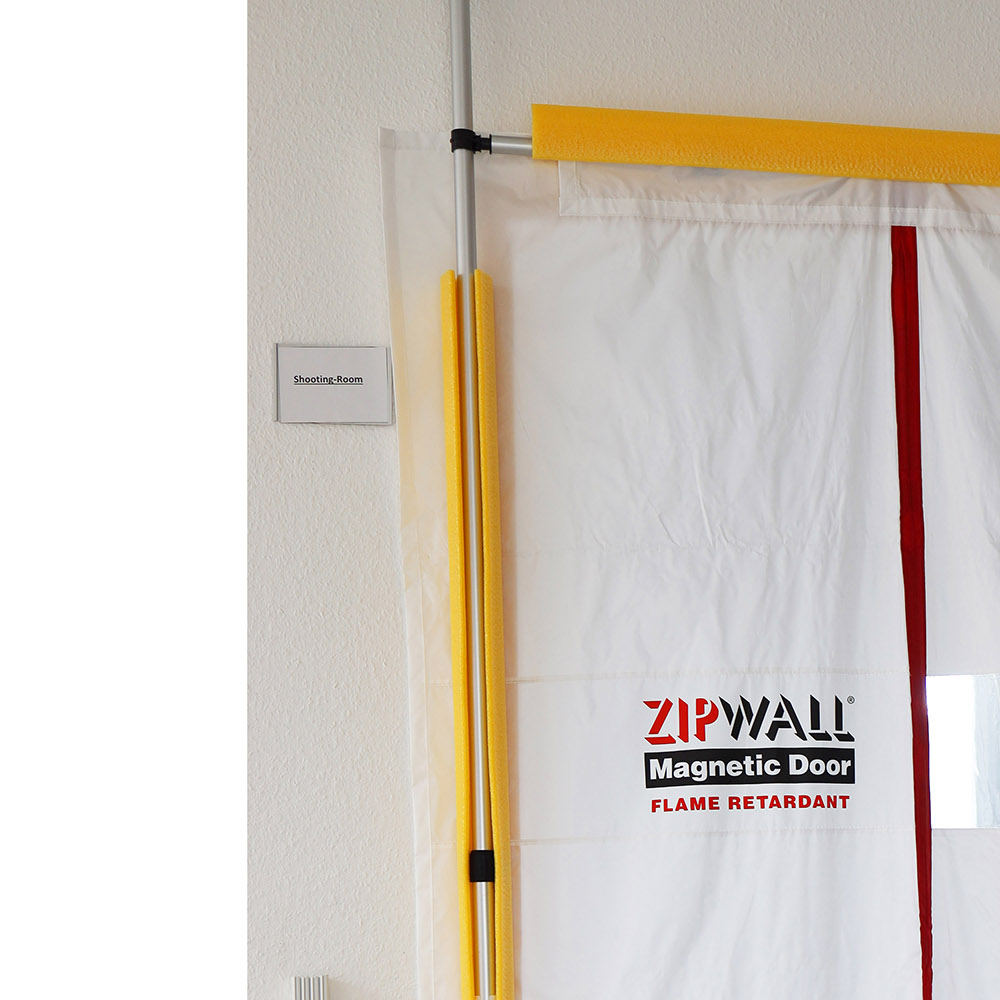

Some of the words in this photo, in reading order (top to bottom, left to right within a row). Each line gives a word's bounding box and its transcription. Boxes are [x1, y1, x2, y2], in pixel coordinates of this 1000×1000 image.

[293, 374, 364, 386] Shooting-Room
[649, 754, 781, 782] Magnetic
[788, 754, 852, 776] Door
[651, 796, 720, 813] FLAME
[728, 794, 850, 810] RETARDANT
